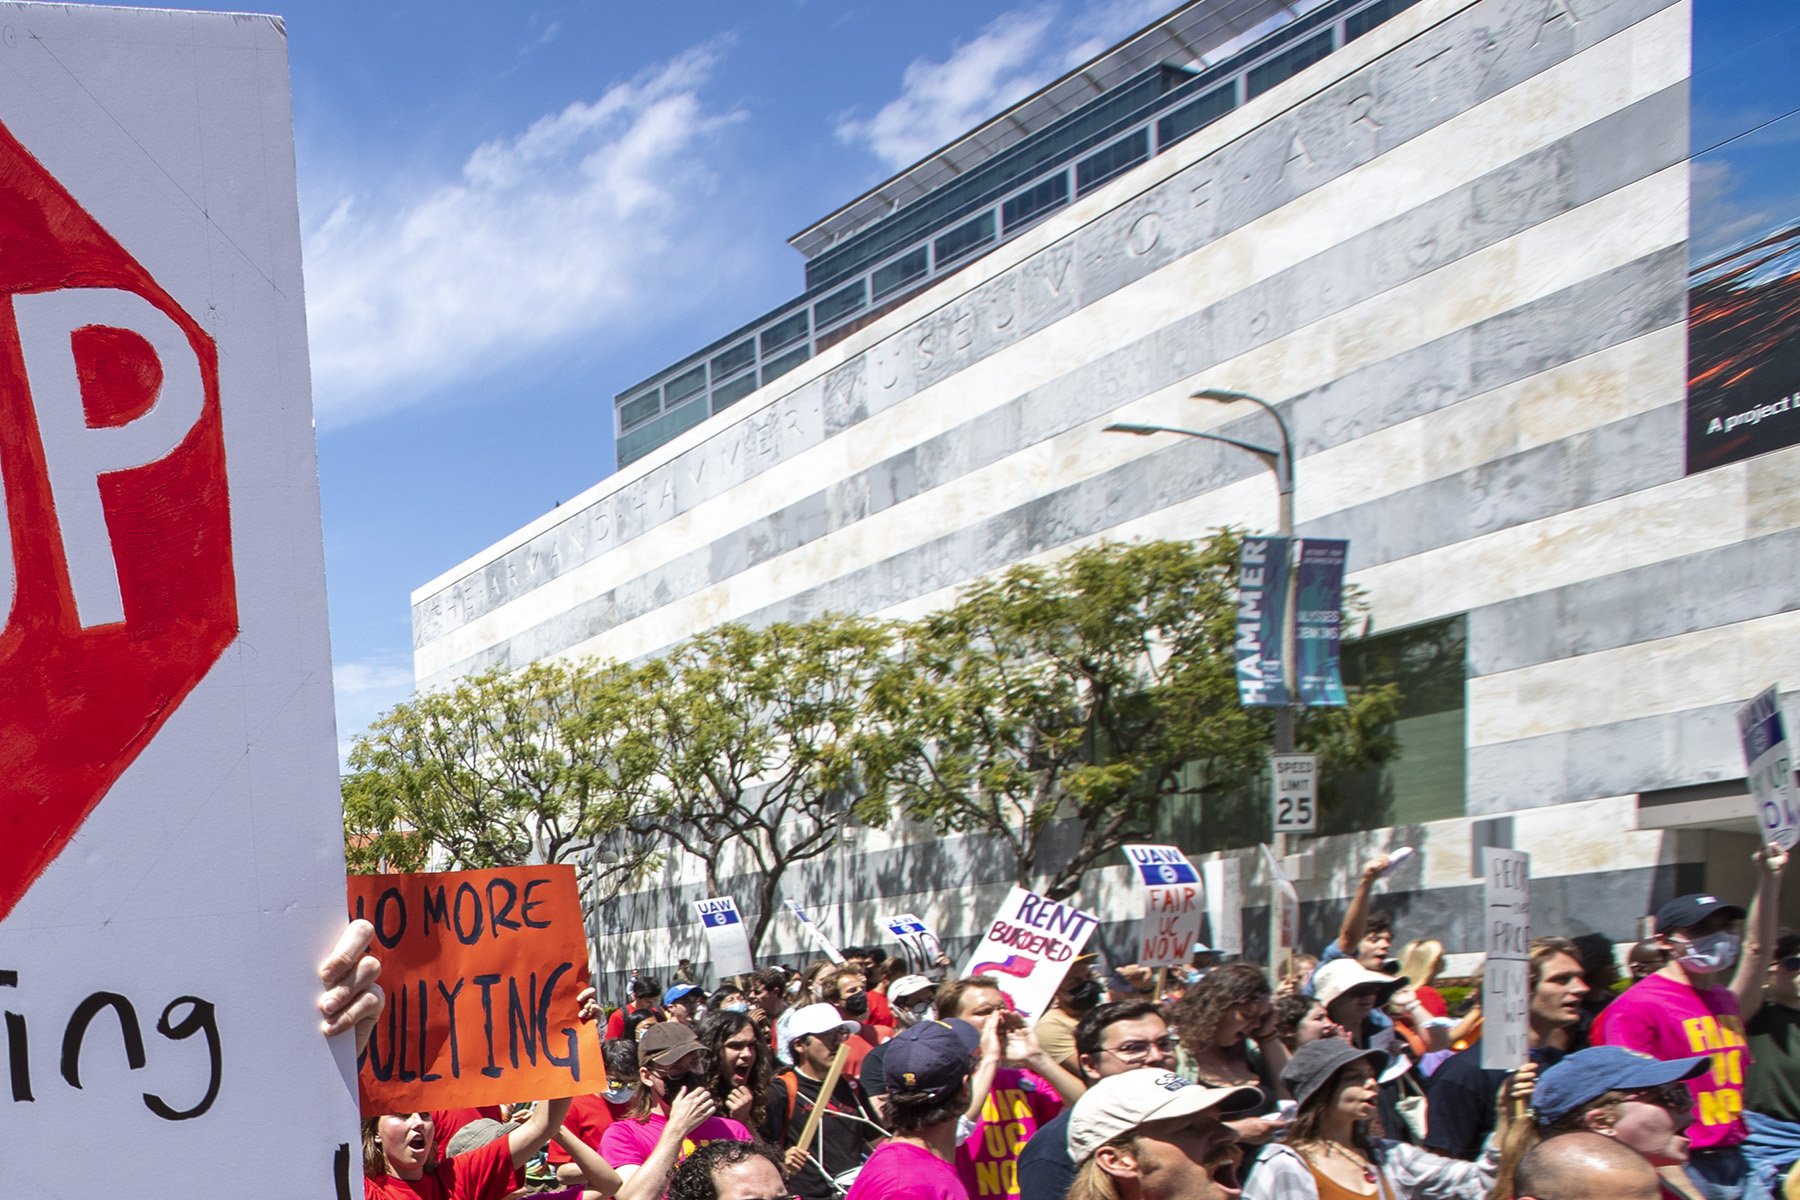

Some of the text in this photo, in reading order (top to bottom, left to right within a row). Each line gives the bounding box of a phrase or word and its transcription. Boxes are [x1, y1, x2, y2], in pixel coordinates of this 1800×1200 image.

[1706, 417, 1723, 435] A
[1723, 396, 1792, 433] project
[1235, 540, 1269, 703] HAMMER
[1277, 762, 1313, 774] SPEED
[1280, 779, 1310, 792] LIMIT
[1278, 797, 1312, 825] 25
[1131, 849, 1182, 863] UAW
[423, 877, 554, 946] MORE
[697, 899, 732, 914] UAW
[1015, 893, 1099, 942] RENT
[1149, 887, 1196, 914] FAIR
[988, 921, 1073, 962] BURDENED
[1158, 916, 1180, 937] UC
[1142, 931, 1194, 961] NOW
[358, 962, 582, 1083] ULLYING
[981, 1089, 1033, 1123] AIR
[983, 1123, 1028, 1158] UC
[975, 1159, 1021, 1196] NO
